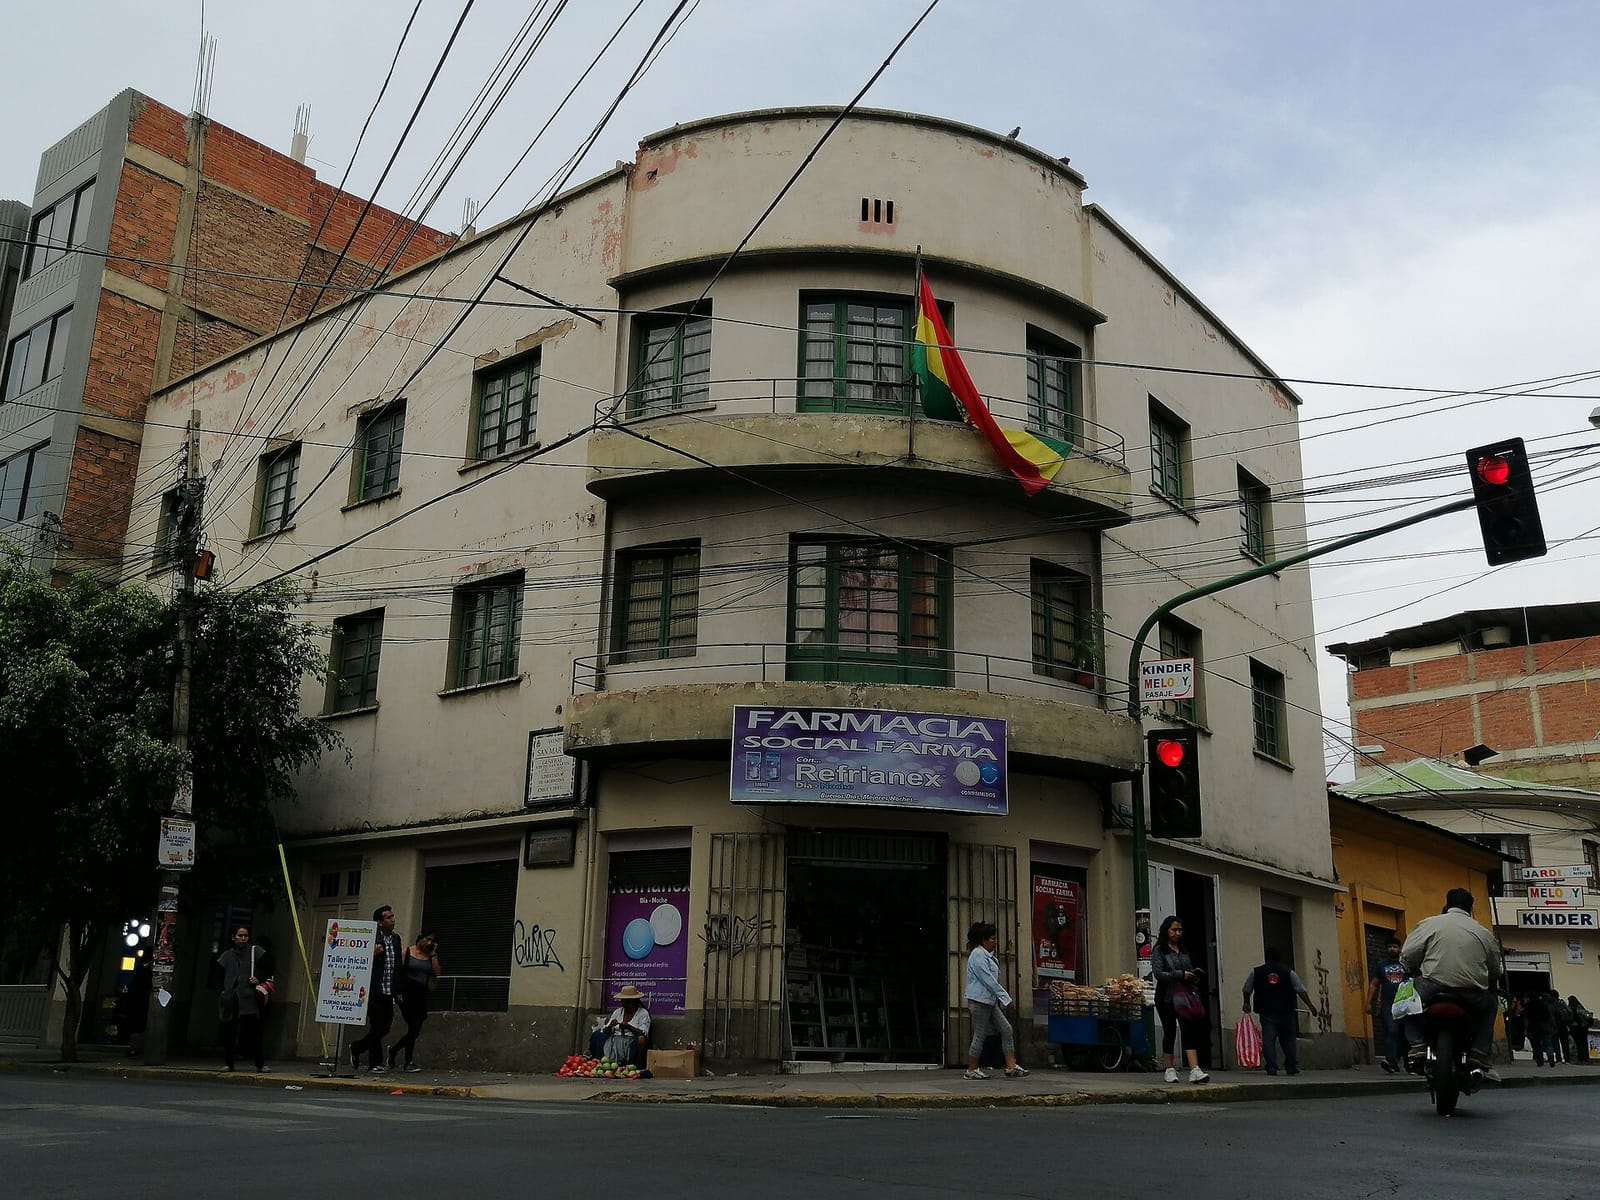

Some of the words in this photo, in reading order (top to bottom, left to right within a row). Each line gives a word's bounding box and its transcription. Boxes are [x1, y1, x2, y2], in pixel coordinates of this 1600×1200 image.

[1142, 663, 1191, 675] KINDER
[1145, 690, 1174, 698] PASAJE
[747, 710, 994, 742] FARMACIA
[743, 735, 869, 752] SOCIAL
[875, 740, 998, 761] FARMA
[795, 763, 942, 788] Refrianex
[1035, 886, 1055, 895] SOCIAL
[1522, 913, 1593, 926] KINDER
[333, 938, 370, 949] MELODY
[327, 954, 347, 963] Taller
